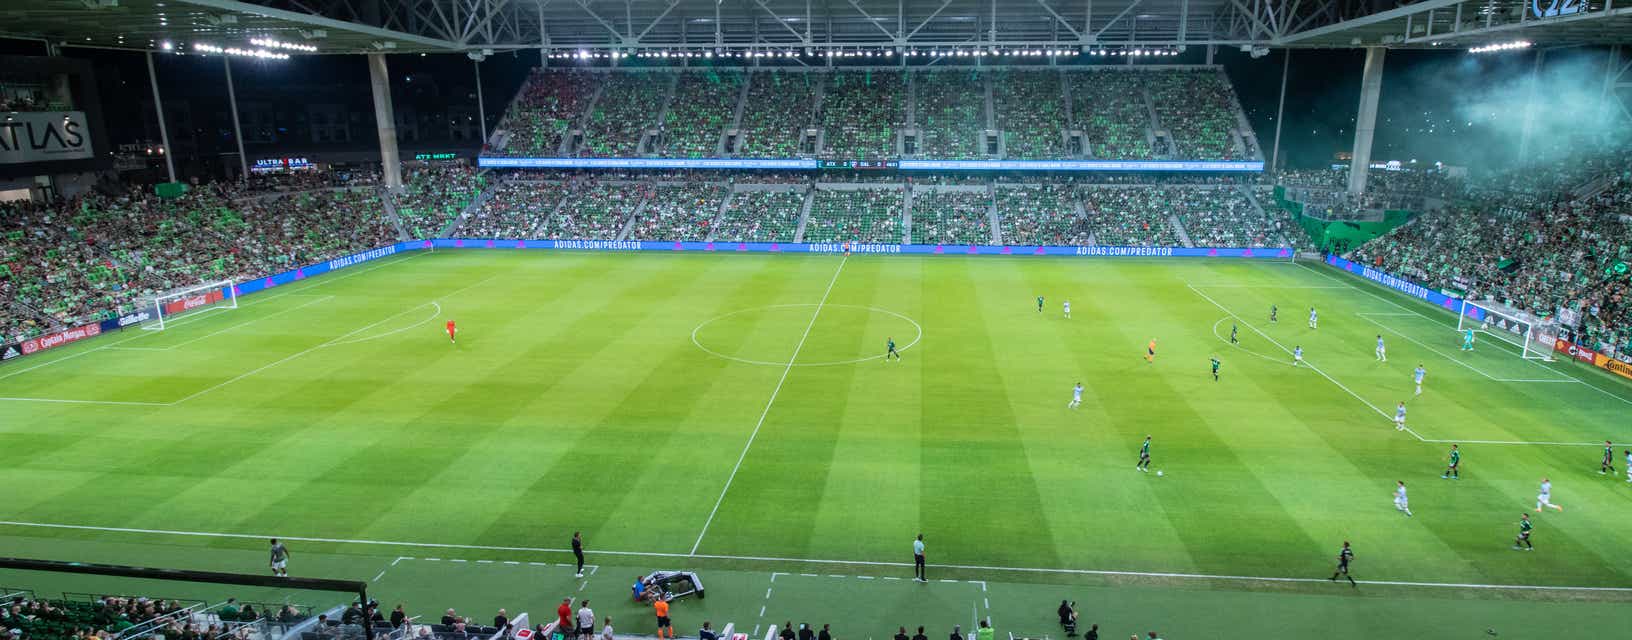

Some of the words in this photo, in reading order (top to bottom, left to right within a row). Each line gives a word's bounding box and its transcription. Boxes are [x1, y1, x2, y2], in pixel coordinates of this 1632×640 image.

[554, 240, 642, 249] ADIDAS.COM/PREDATOR
[1076, 246, 1173, 256] ADIDAS.COM/PREDATOR
[329, 245, 396, 270] ADIDAS.COM/PREDATOR
[1363, 267, 1428, 299] ADIDAS.COM/PREDATOR
